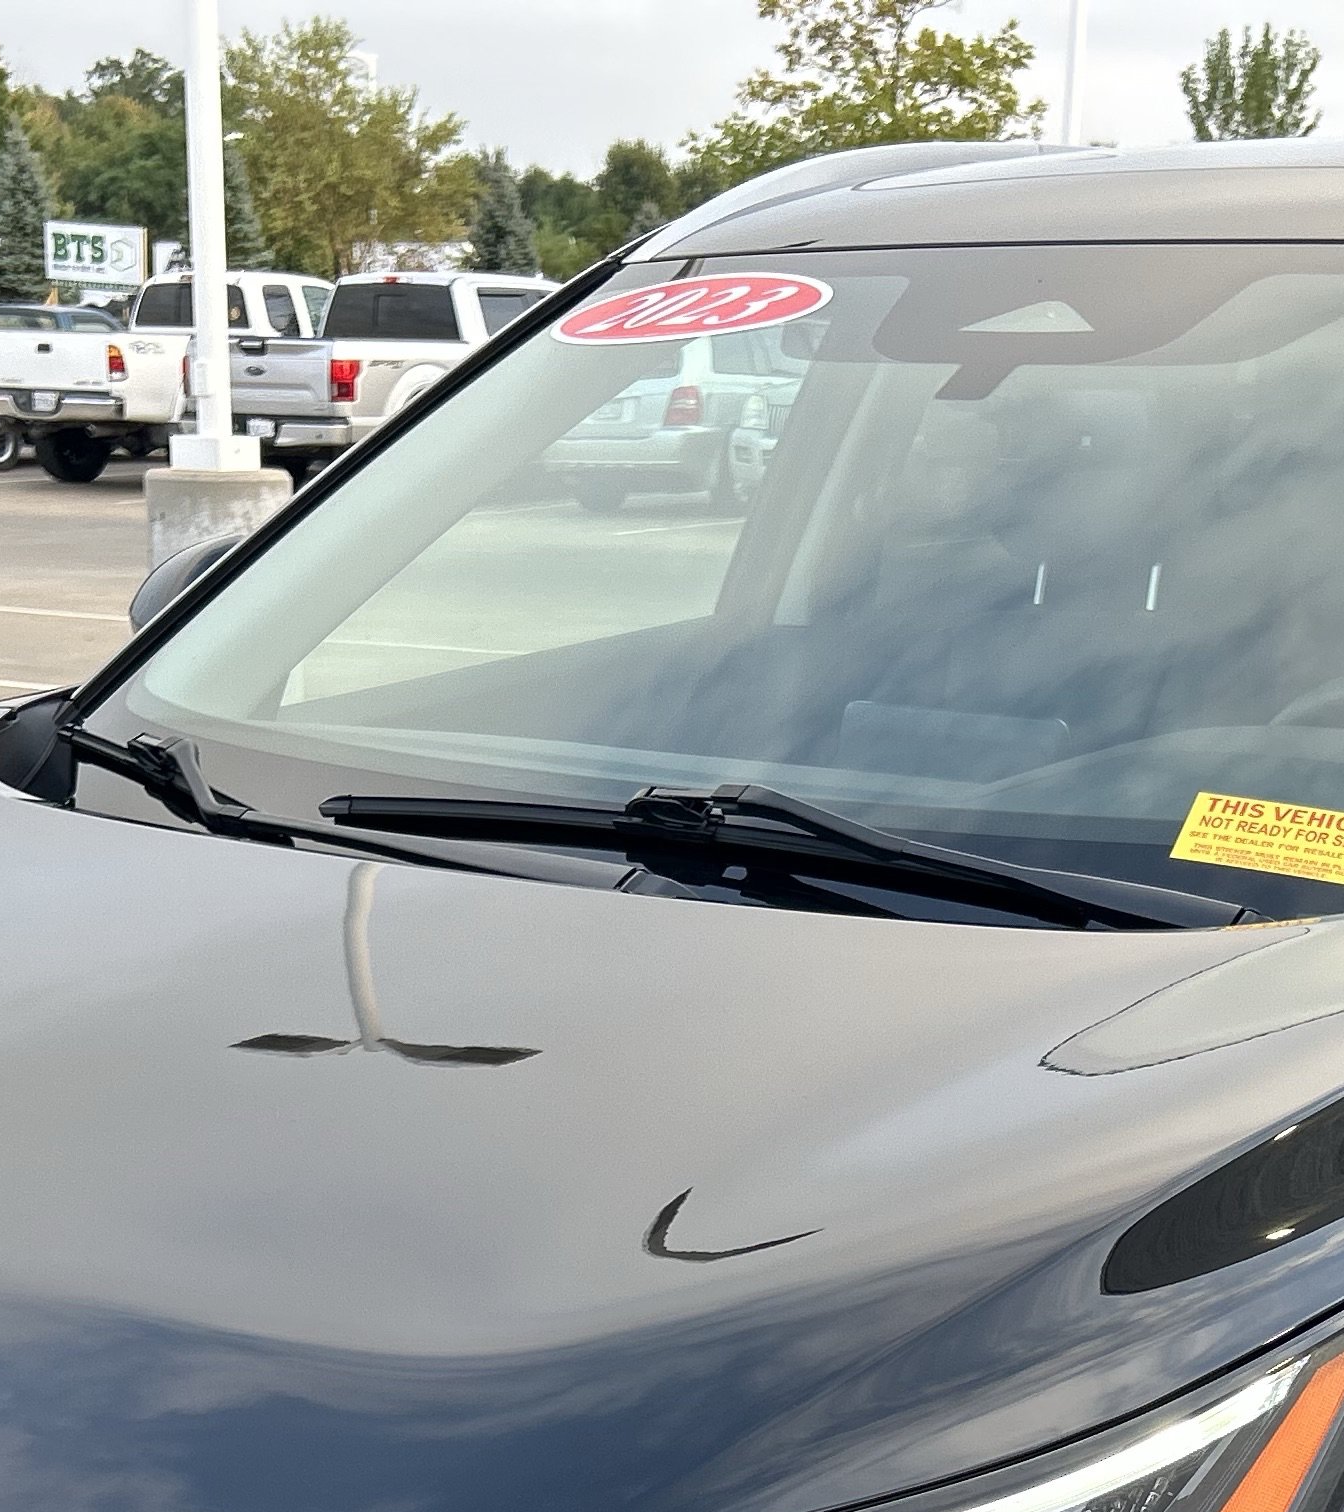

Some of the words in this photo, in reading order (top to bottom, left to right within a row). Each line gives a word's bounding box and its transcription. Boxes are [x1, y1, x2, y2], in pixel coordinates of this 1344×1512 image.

[52, 232, 105, 264] BTS
[574, 285, 799, 335] 2023
[1207, 797, 1266, 819] THIS
[1198, 814, 1234, 830] NOT
[1234, 820, 1292, 839] READY
[1293, 828, 1330, 844] FOR
[1188, 830, 1208, 838] SEE
[1211, 833, 1231, 842] THE
[1234, 837, 1274, 848] DEALER
[1277, 843, 1300, 852] FOR
[1302, 847, 1343, 859] RESALE
